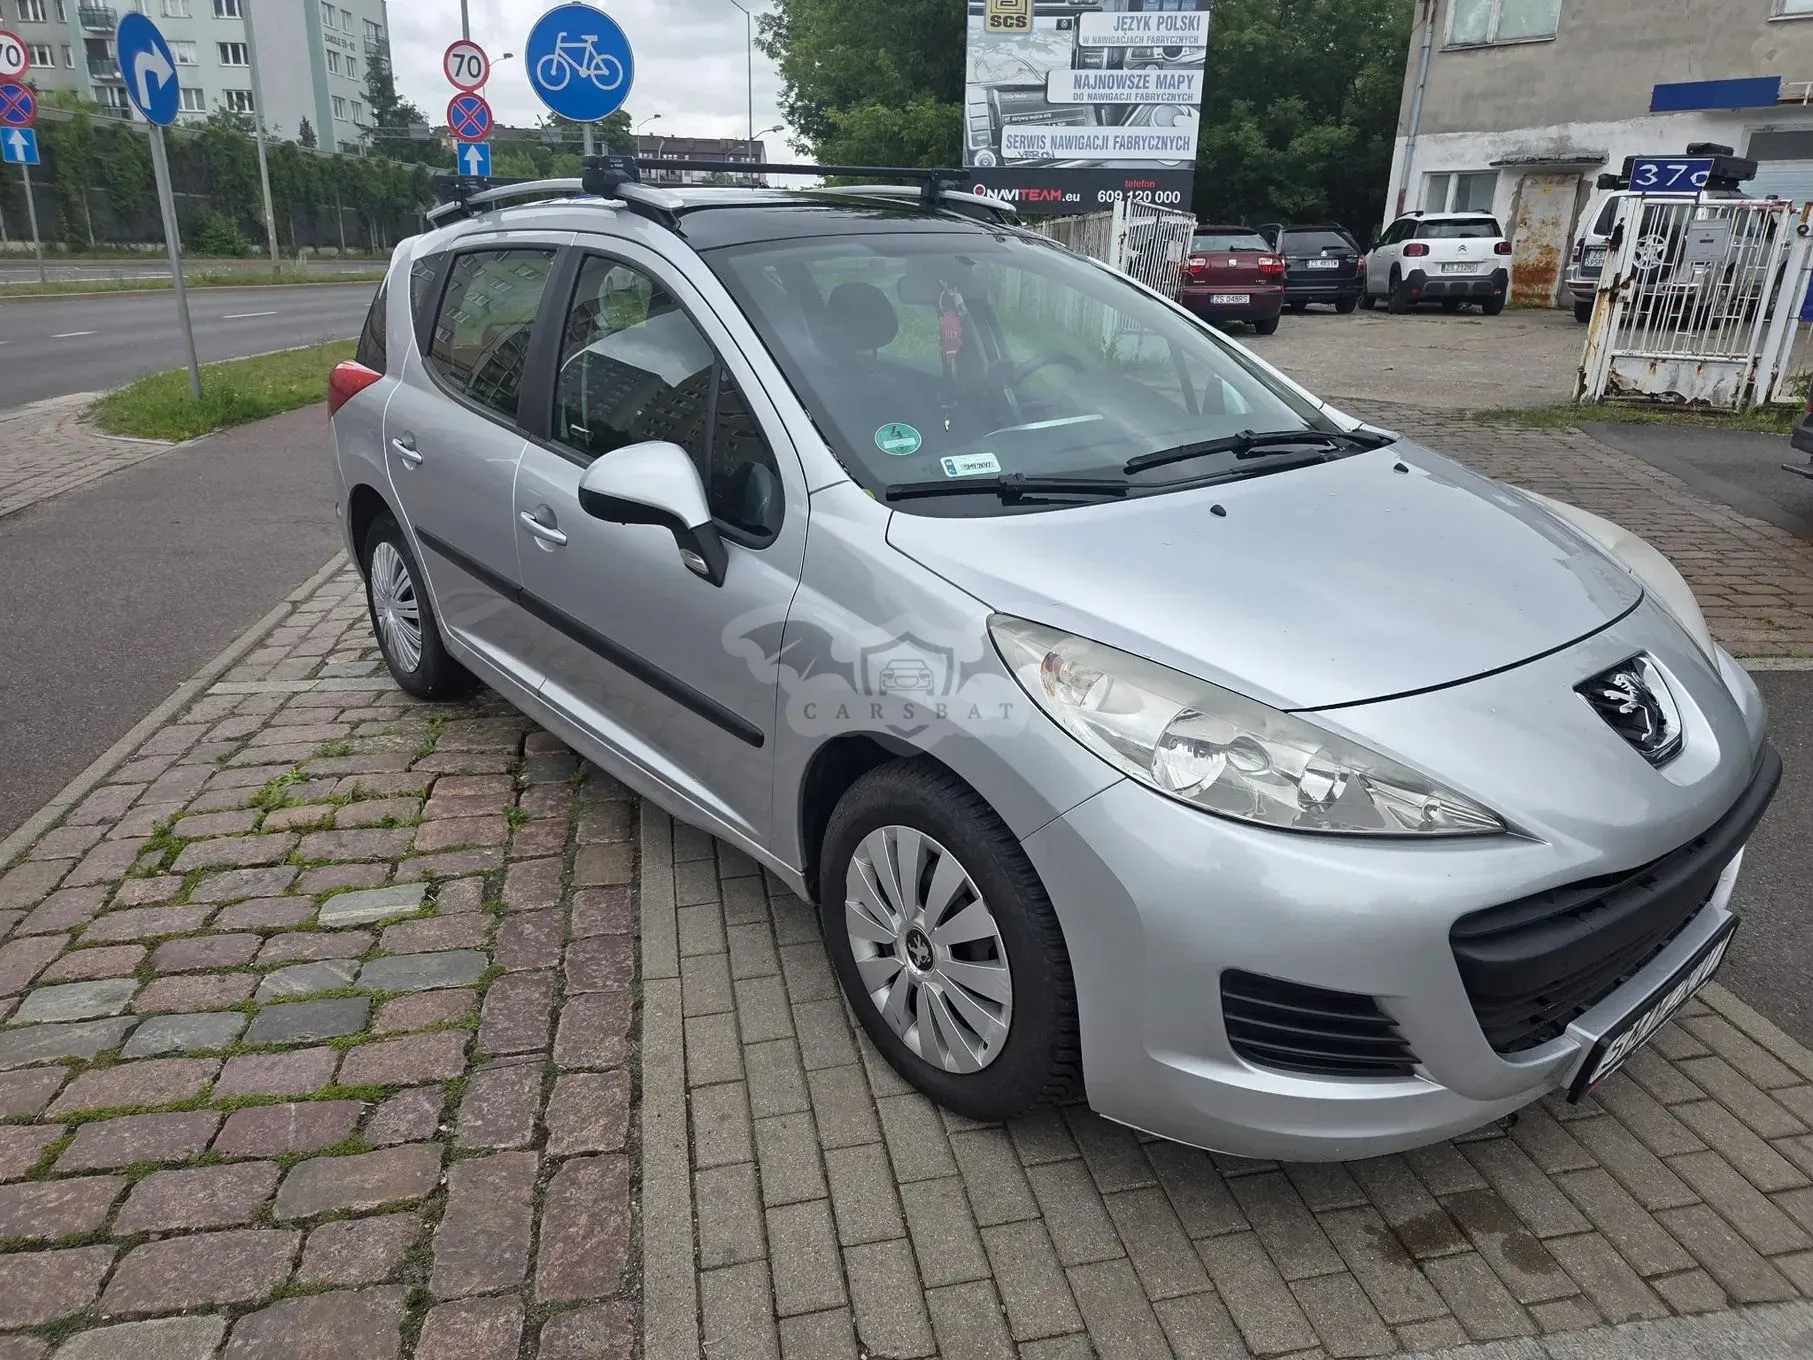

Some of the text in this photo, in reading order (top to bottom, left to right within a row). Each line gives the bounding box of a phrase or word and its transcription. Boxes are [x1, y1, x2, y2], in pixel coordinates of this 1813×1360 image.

[990, 15, 1027, 28] SCS
[1113, 15, 1201, 35] JĘZYK POLSKI
[1082, 35, 1199, 45] W NAWIGACJACH FABRYCZNYCH
[452, 53, 482, 79] 70
[1073, 74, 1195, 90] NAJNOWSZE MAPY
[1073, 92, 1194, 102] DO NAWIGACJI FABRYCZNYCH
[1006, 134, 1191, 151] SERWIS NAWIGACJI FABRYCZNYCH
[1124, 179, 1156, 188] telefon
[1097, 190, 1123, 203] 609
[1126, 191, 1152, 202] 120
[1155, 190, 1181, 203] 000
[1214, 295, 1248, 303] ZS 048RS
